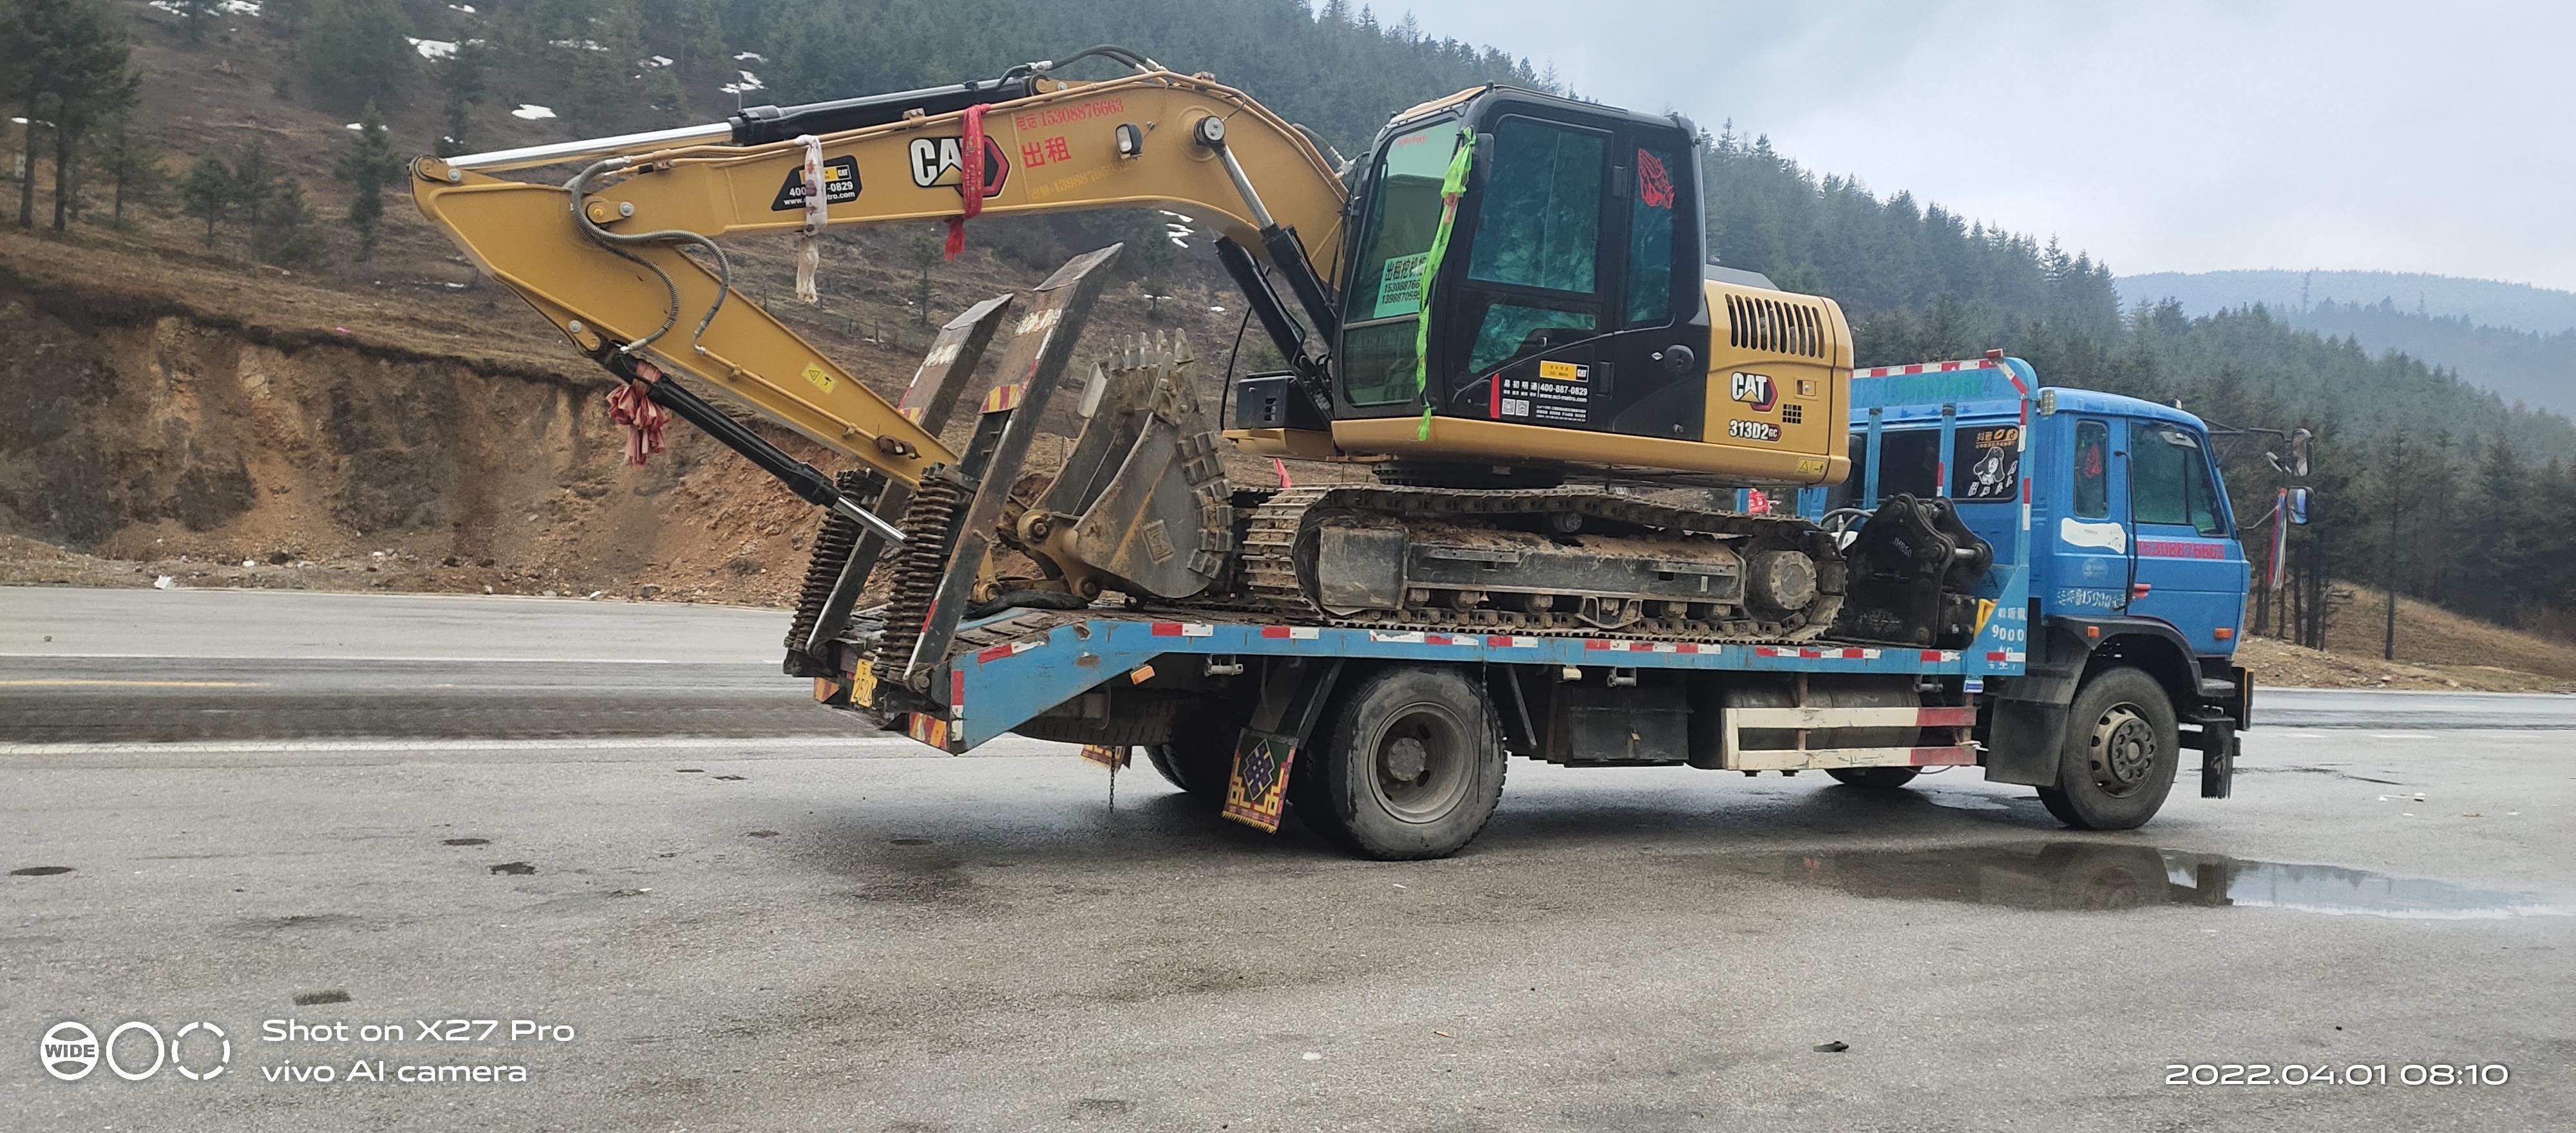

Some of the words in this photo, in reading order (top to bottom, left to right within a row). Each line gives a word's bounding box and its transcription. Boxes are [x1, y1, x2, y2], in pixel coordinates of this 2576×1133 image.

[1021, 136, 1072, 169] 出租
[910, 138, 963, 187] CA
[790, 182, 853, 196] 400-0829
[784, 192, 855, 205] www.tro.com
[1540, 383, 1588, 396] 400-887-0829
[1732, 372, 1767, 404] CAT
[1729, 420, 1769, 440] 313D2
[1768, 428, 1778, 438] GC
[1992, 624, 2025, 641] 9000
